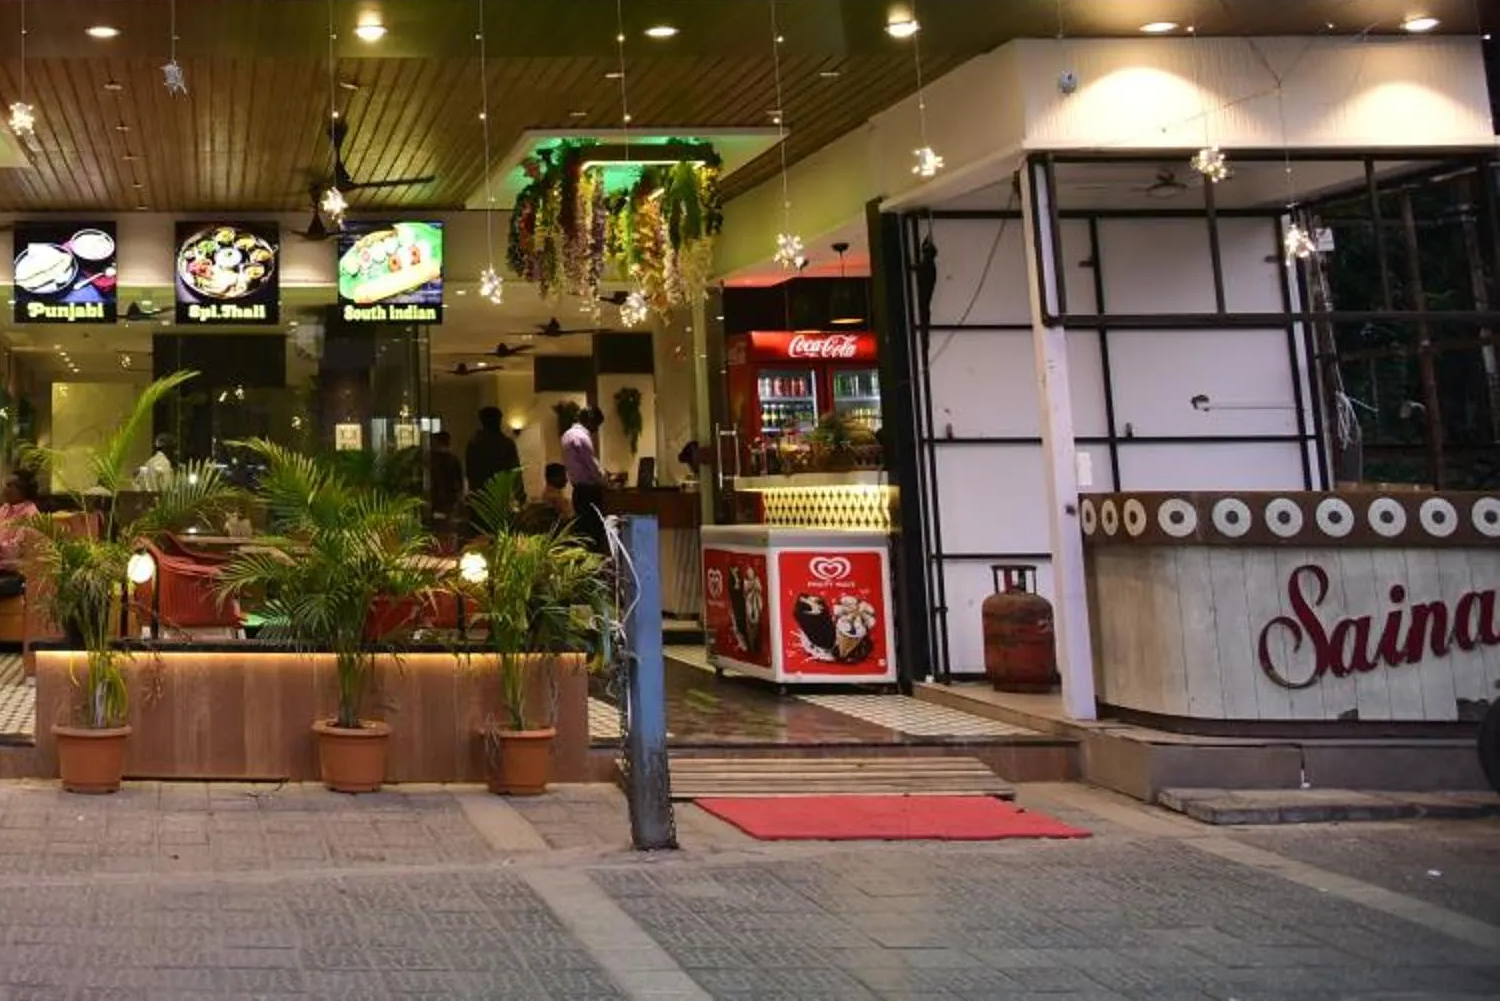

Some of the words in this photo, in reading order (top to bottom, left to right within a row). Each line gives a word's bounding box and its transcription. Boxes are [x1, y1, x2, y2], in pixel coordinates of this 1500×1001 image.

[28, 302, 105, 322] Punjabi
[343, 304, 386, 320] South
[1258, 563, 1500, 690] Saina
